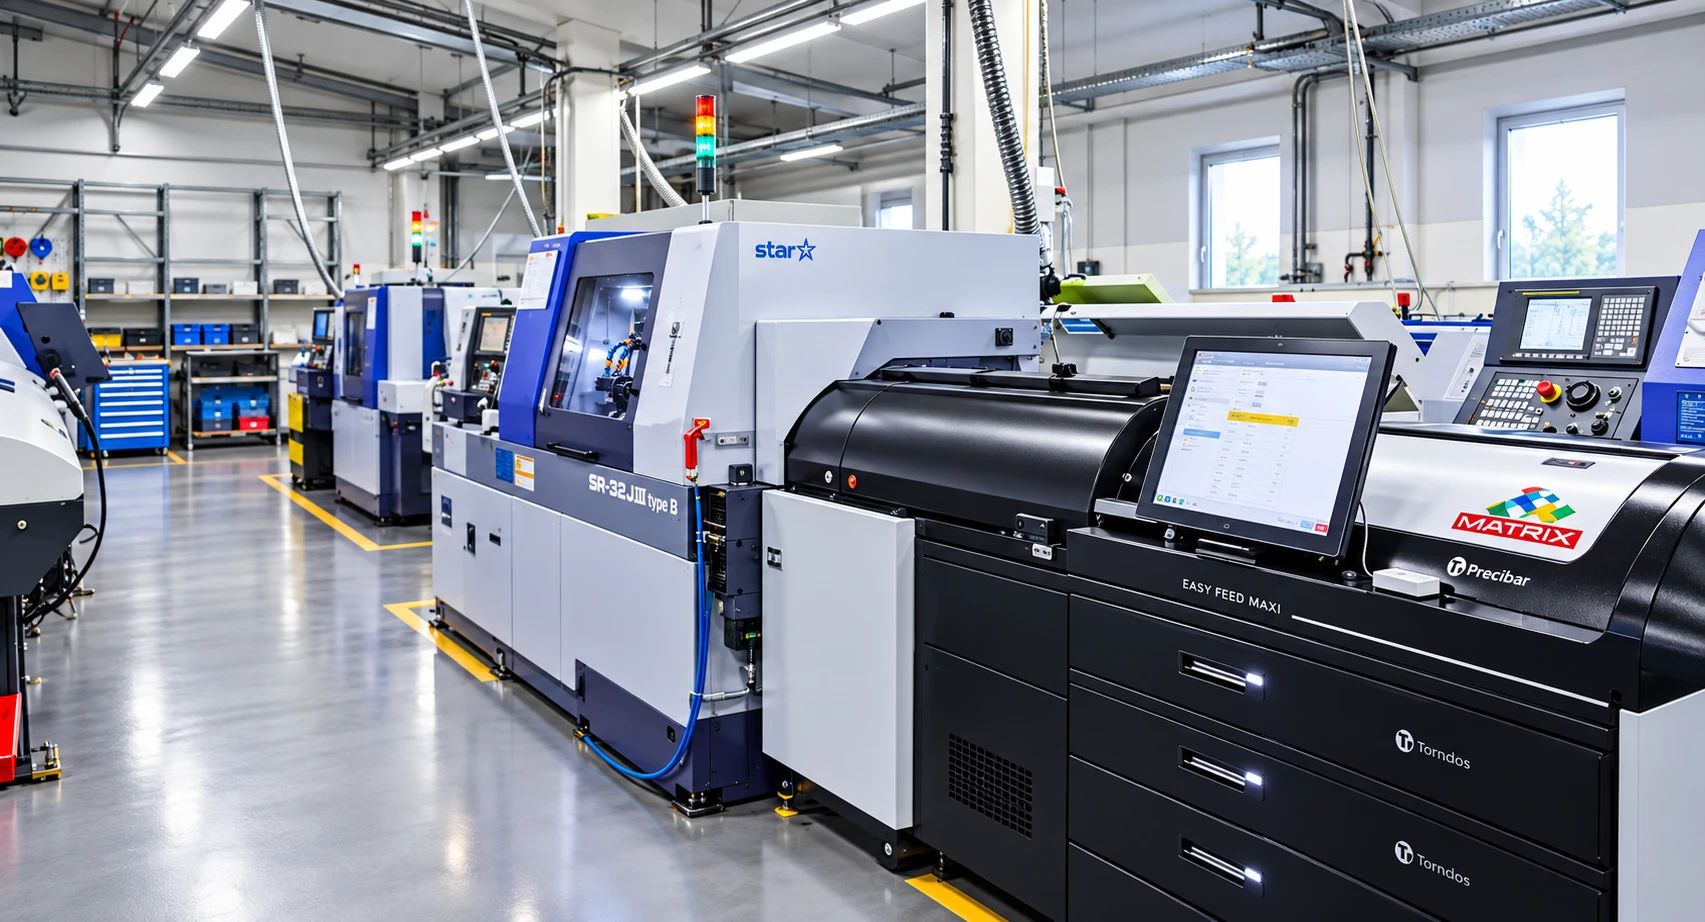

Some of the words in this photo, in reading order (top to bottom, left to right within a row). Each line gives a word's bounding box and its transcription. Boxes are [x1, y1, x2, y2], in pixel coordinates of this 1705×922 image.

[755, 241, 796, 259] star
[647, 493, 668, 514] type
[670, 498, 678, 515] B
[1457, 515, 1576, 546] MATRIX
[1466, 564, 1531, 587] Precibar
[1182, 578, 1212, 595] EASY
[1215, 587, 1245, 604] FEED
[1248, 596, 1281, 614] MAXI
[1417, 740, 1471, 770] Torndos
[1417, 853, 1471, 887] Torndos
